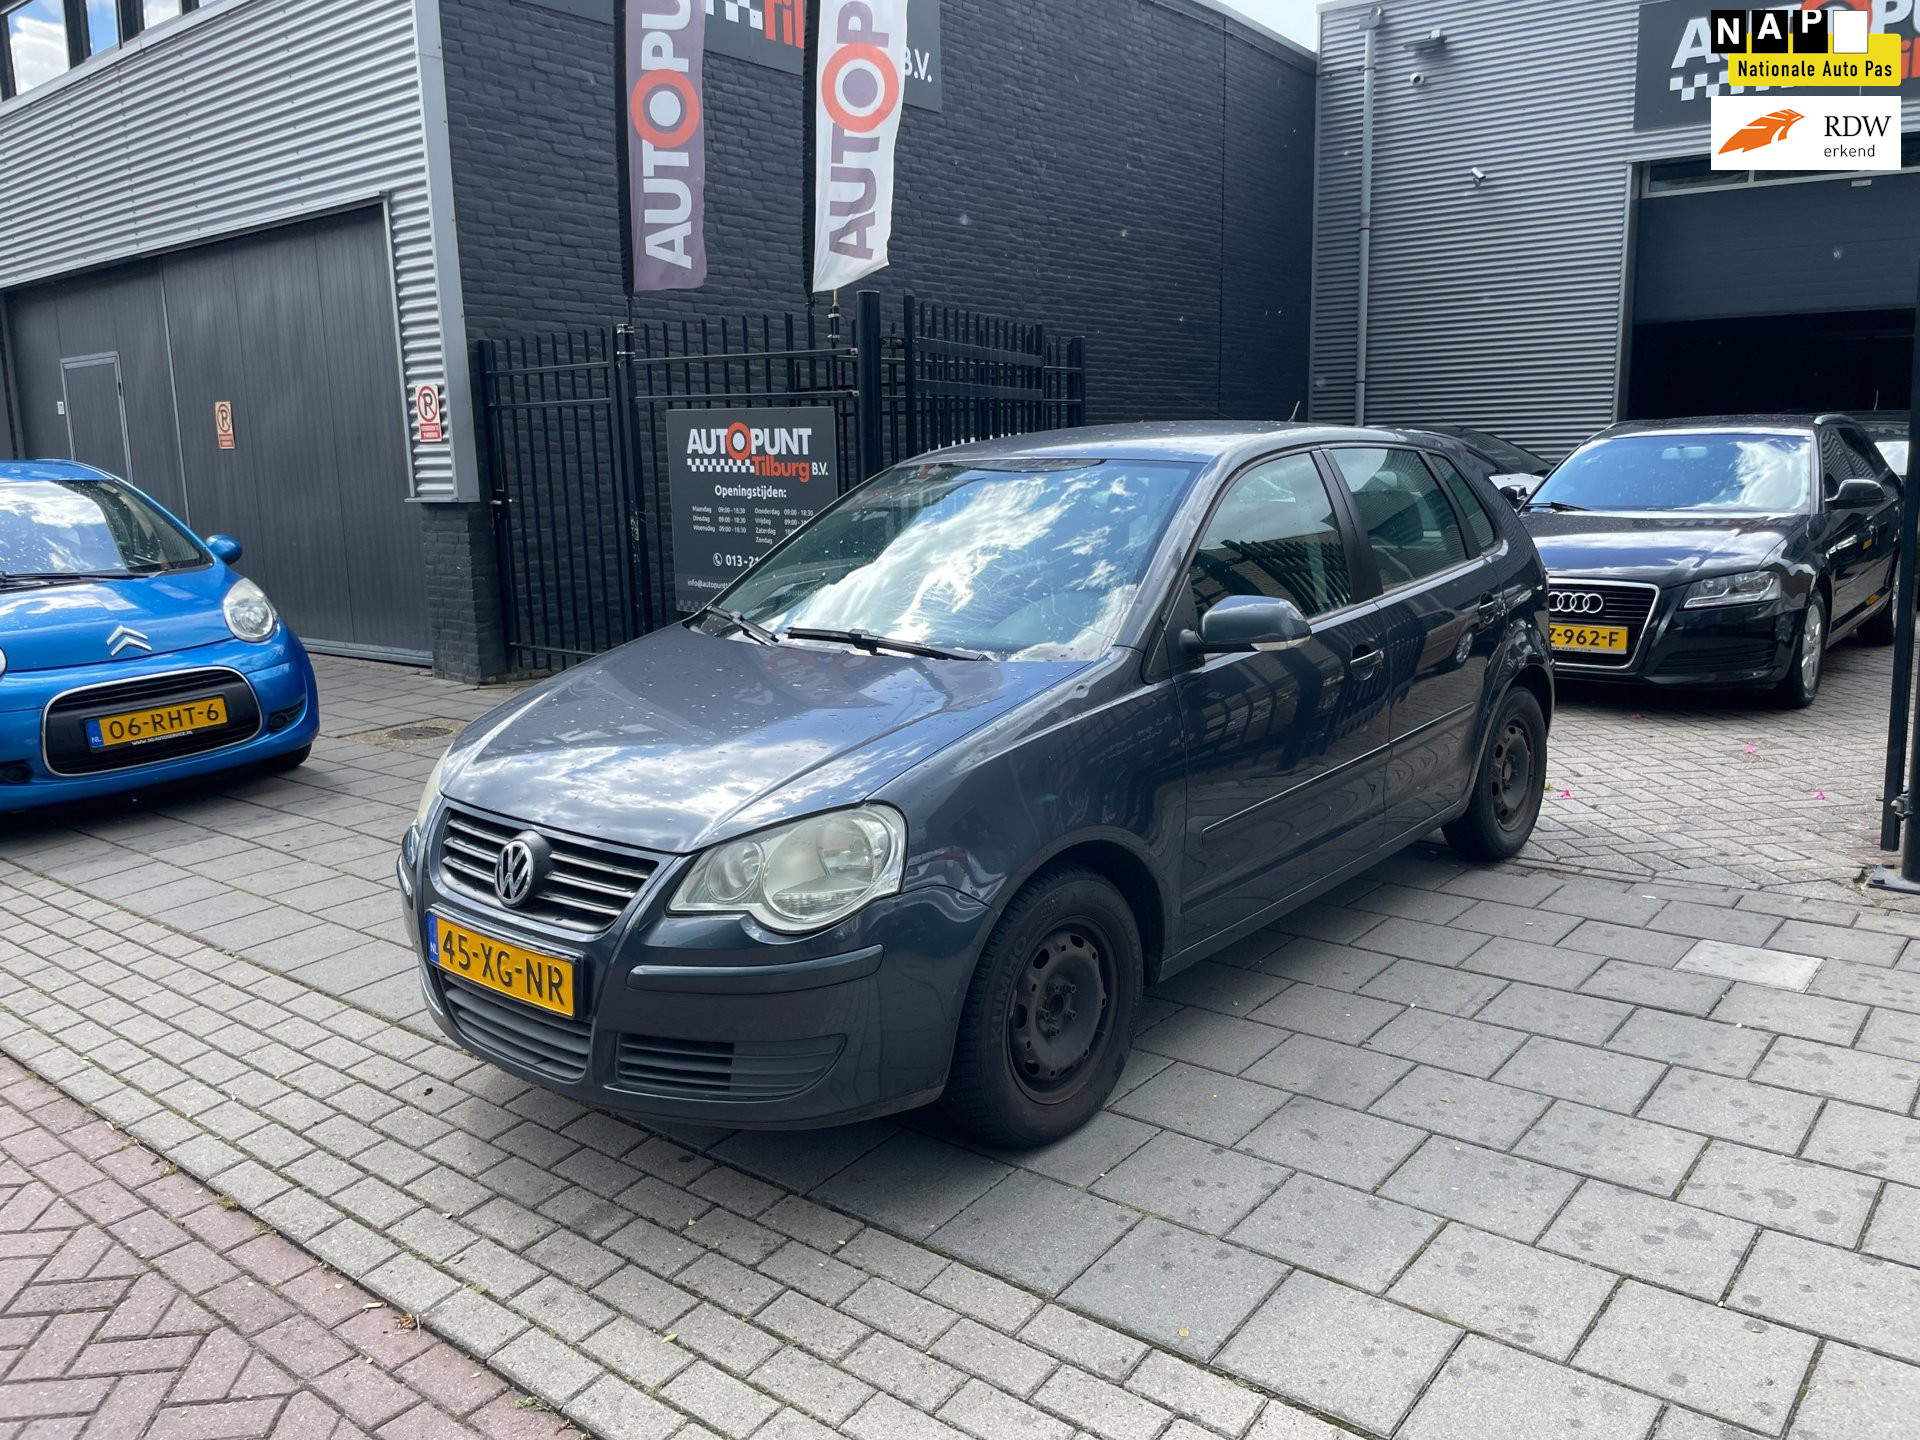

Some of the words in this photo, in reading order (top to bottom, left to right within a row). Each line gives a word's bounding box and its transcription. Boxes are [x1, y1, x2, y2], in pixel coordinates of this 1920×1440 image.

[686, 422, 812, 460] AUTOPUNT
[752, 454, 811, 482] Tilburg
[812, 462, 829, 476] B.V.
[714, 484, 787, 500] Openingstijden:
[91, 736, 102, 744] NL
[109, 703, 219, 740] 06-RHT-6
[430, 943, 438, 956] NL
[442, 929, 564, 1006] 45-XG-NR
[990, 936, 1027, 1043] KUMHO
